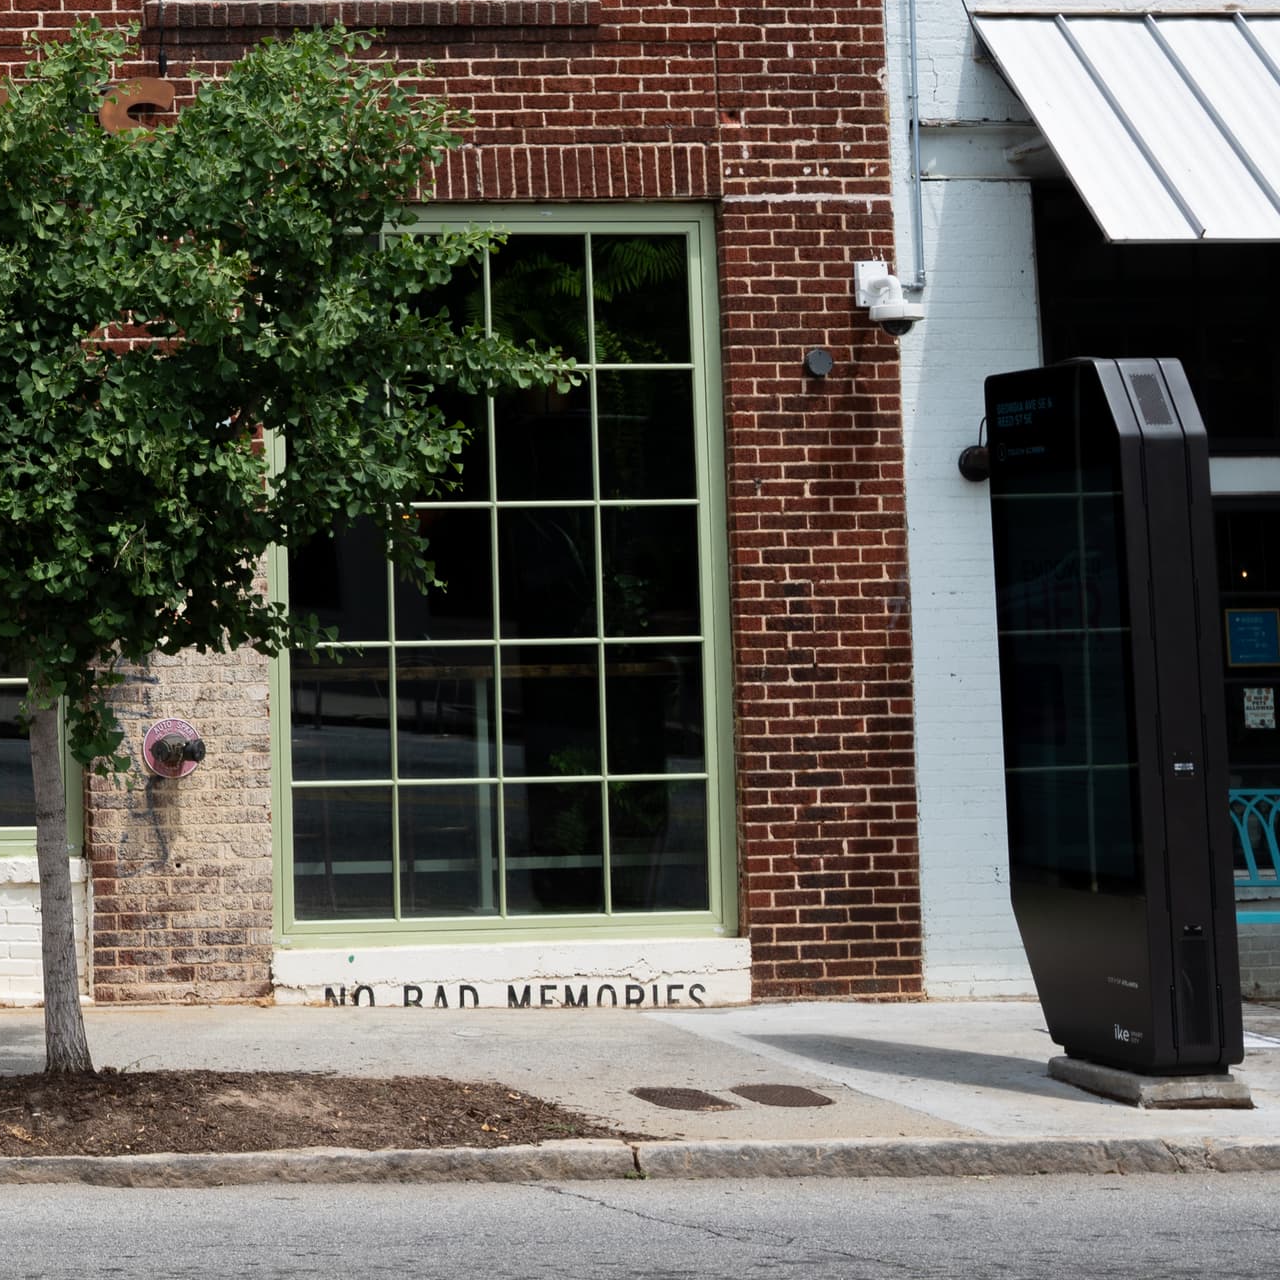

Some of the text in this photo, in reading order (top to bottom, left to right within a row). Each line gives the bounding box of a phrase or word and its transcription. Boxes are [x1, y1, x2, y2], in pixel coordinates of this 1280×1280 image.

[153, 721, 172, 734] AUTO
[324, 983, 376, 1009] NO
[506, 982, 707, 1009] MEMORIES
[1113, 1023, 1130, 1042] ike
